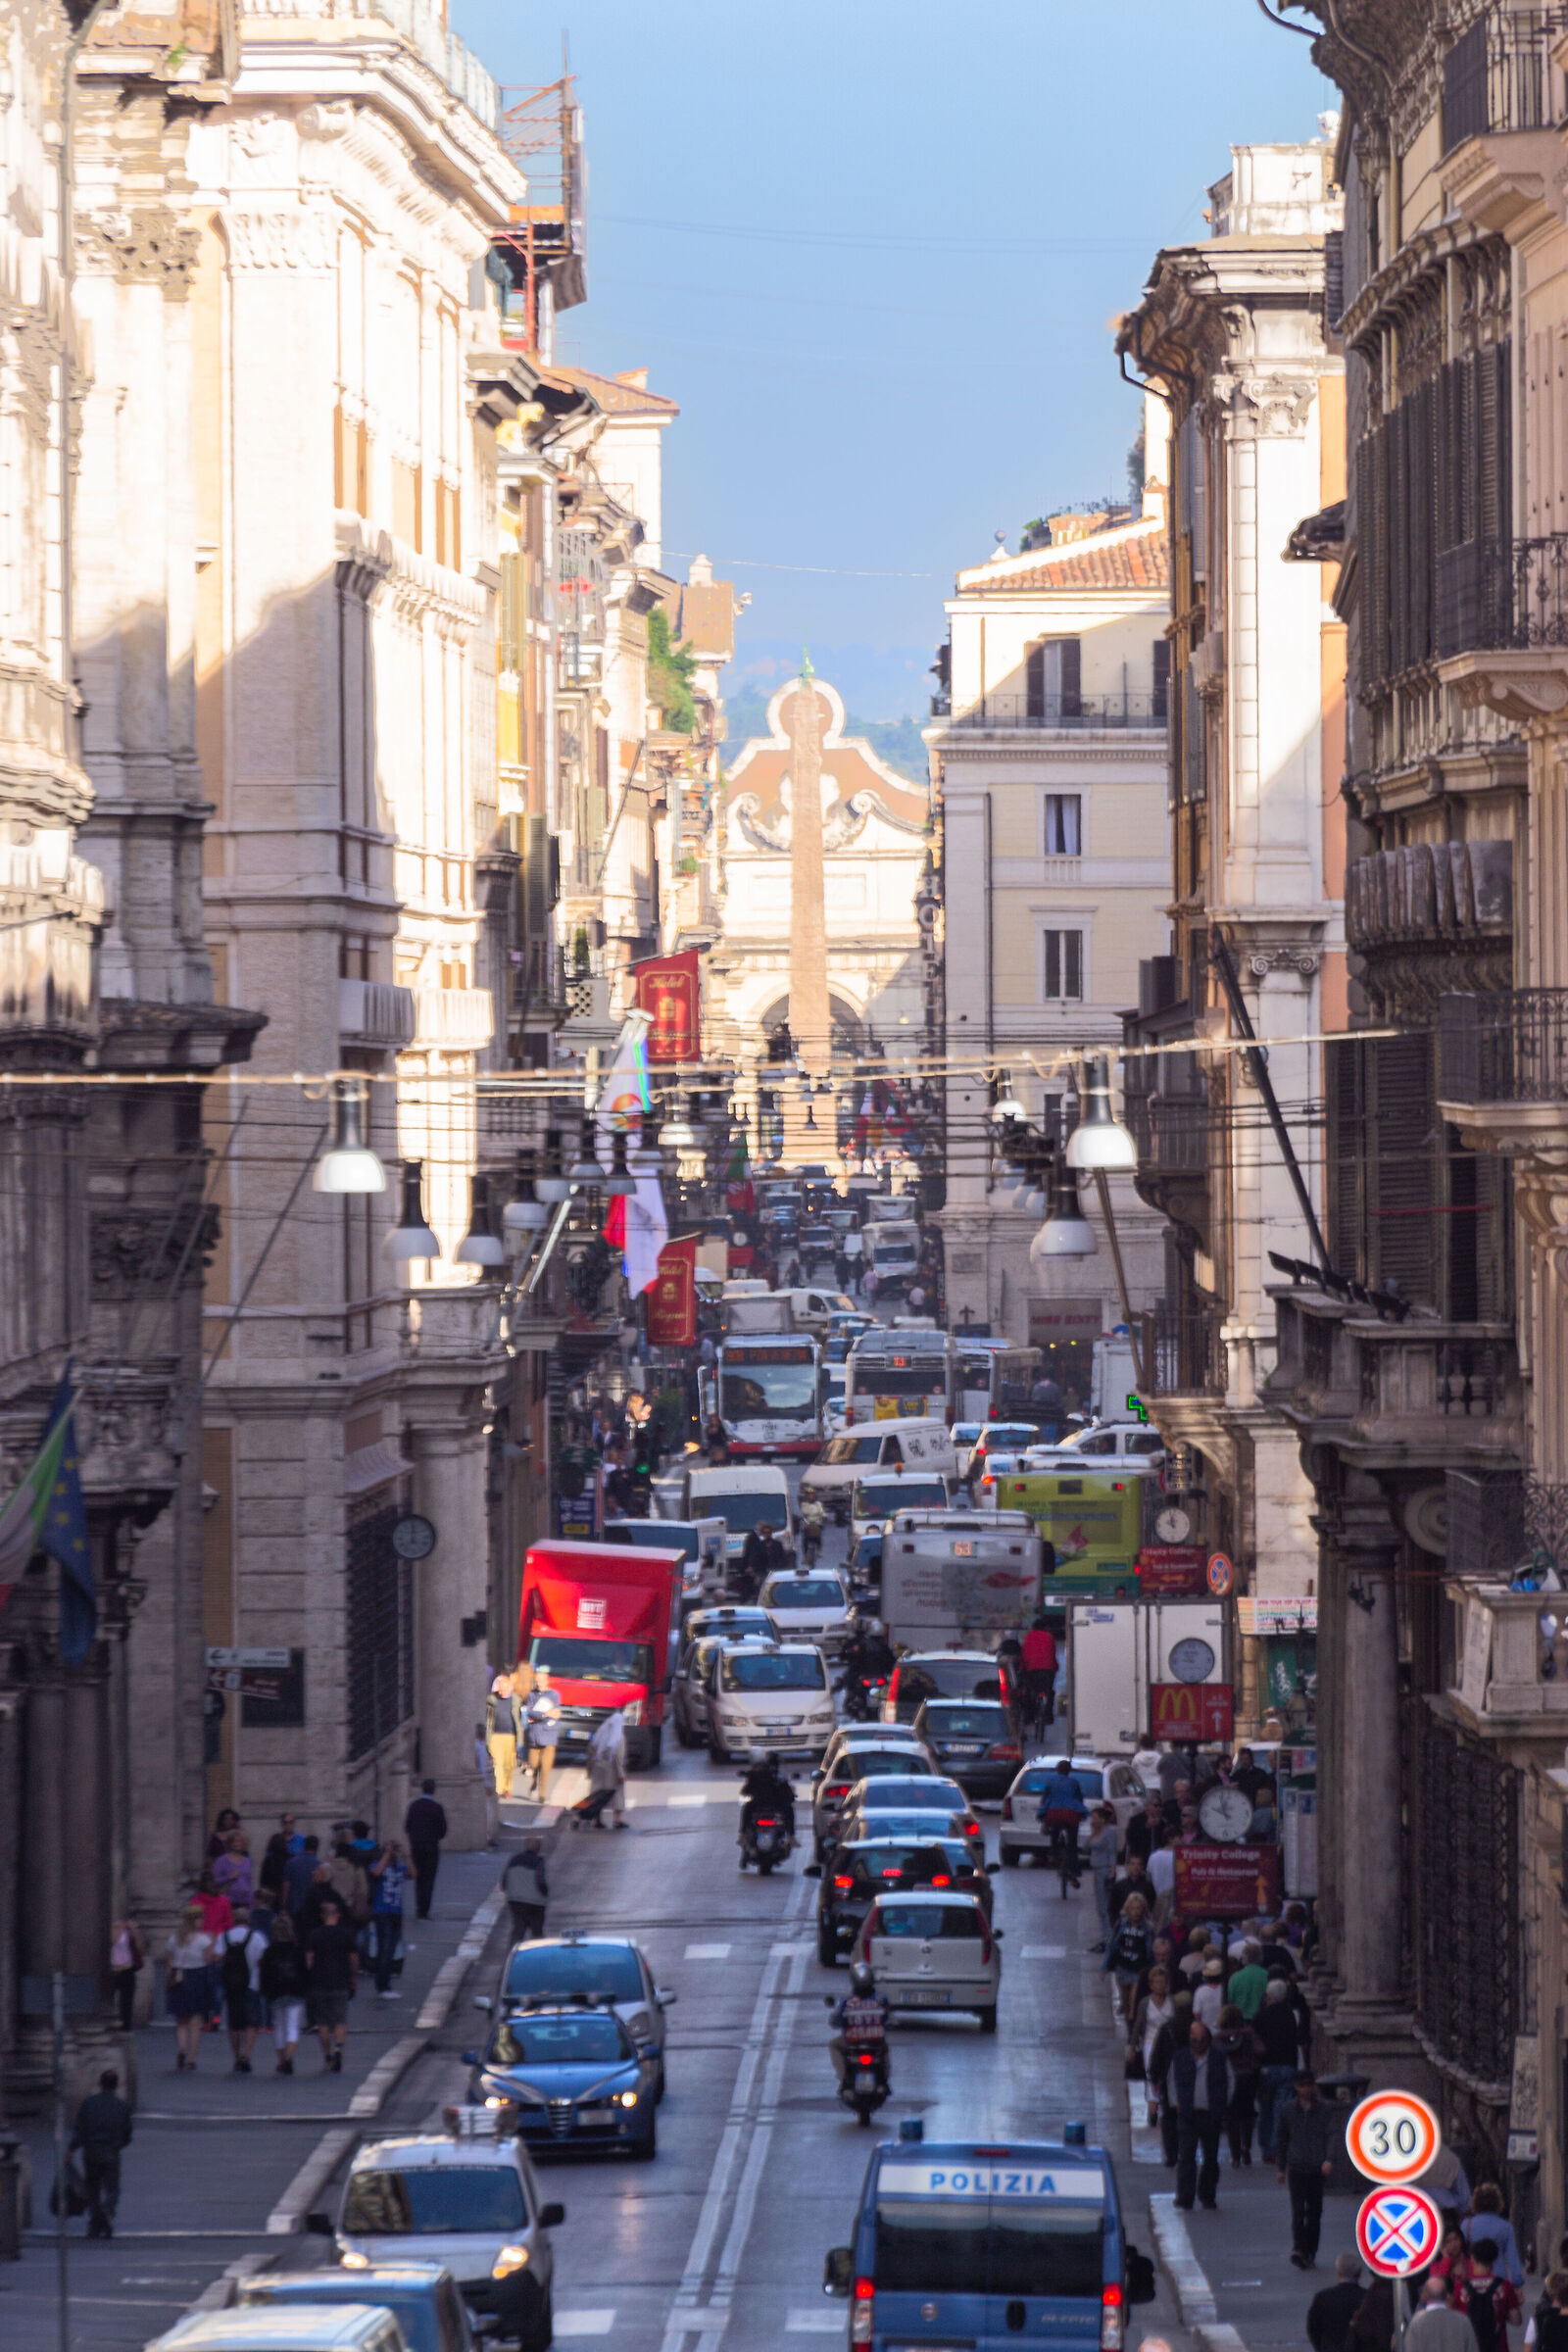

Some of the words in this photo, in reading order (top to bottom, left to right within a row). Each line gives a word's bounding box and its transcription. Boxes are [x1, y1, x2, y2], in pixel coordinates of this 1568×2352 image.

[955, 1541, 972, 1556] 63
[1181, 1849, 1219, 1860] Trinity
[1221, 1849, 1261, 1861] College
[1370, 2118, 1417, 2157] 30
[930, 2173, 1056, 2194] POLIZIA
